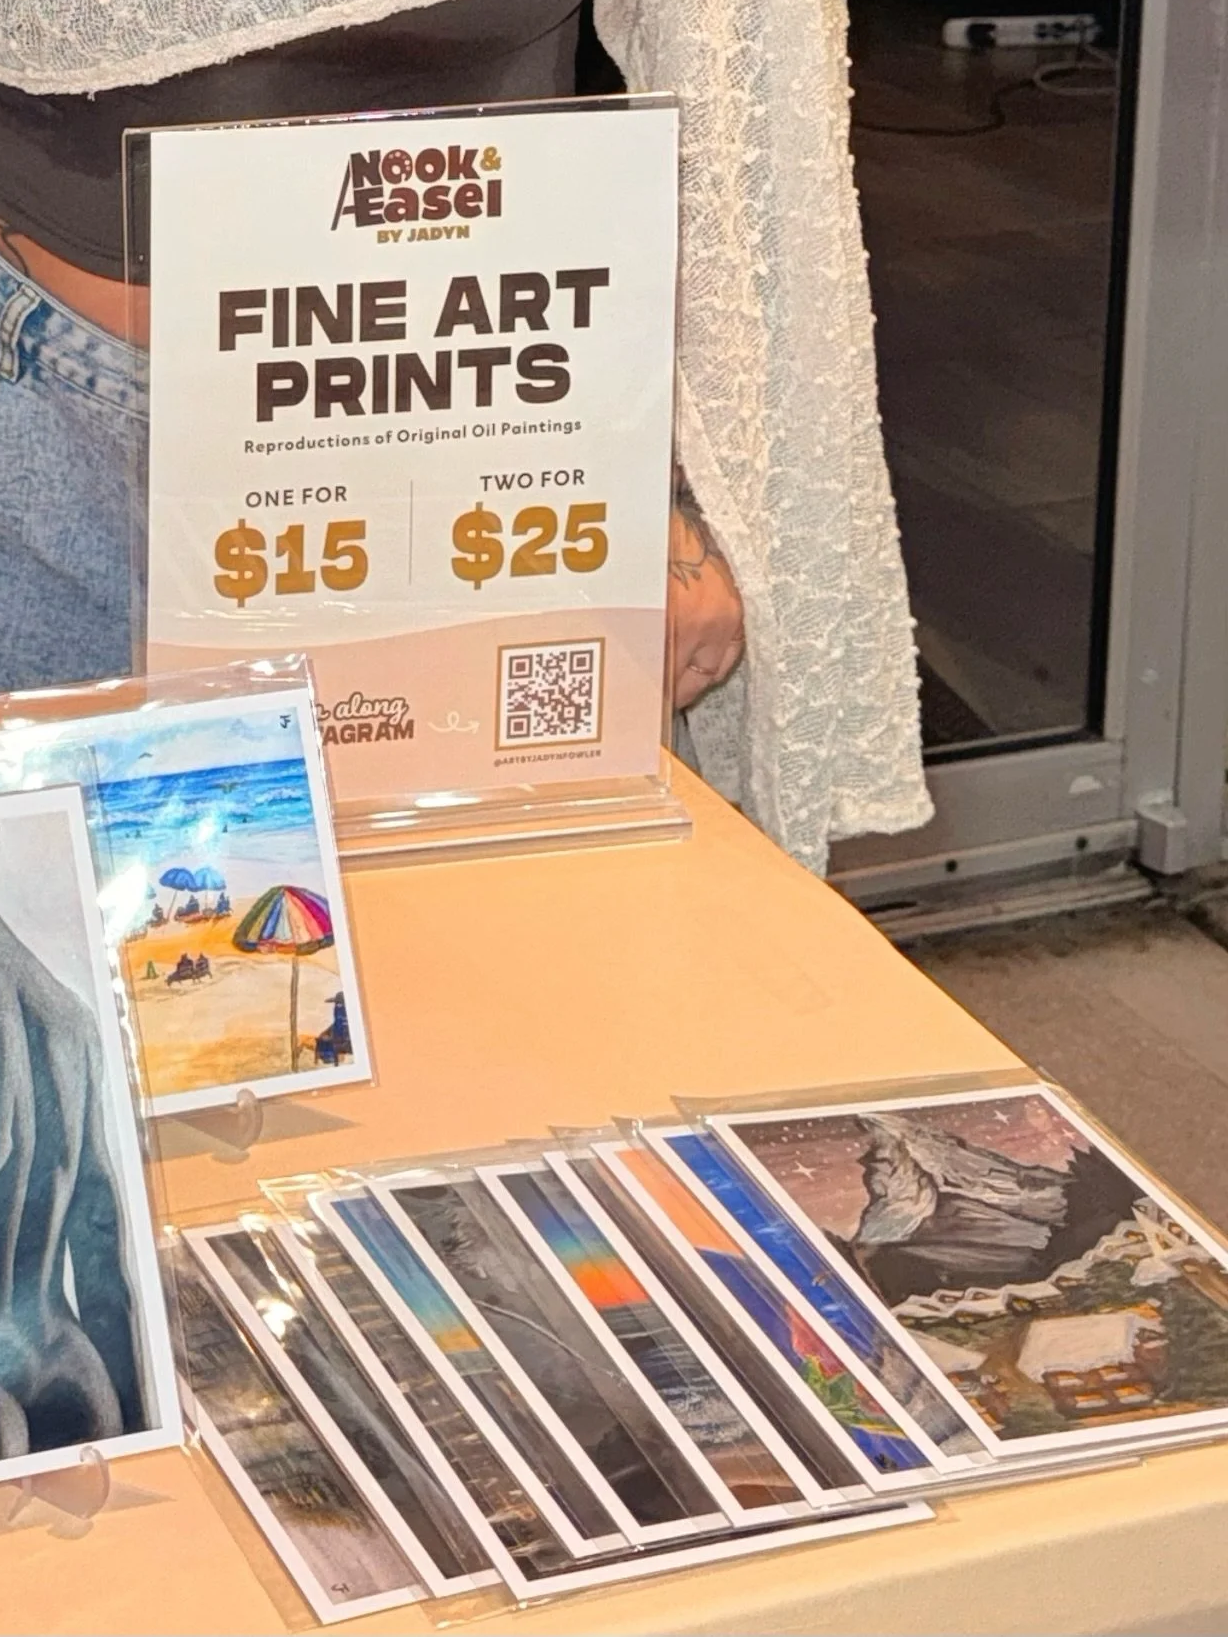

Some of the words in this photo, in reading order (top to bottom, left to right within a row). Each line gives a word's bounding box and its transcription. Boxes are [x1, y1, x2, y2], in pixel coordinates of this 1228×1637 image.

[350, 145, 481, 189] Nook
[480, 146, 502, 171] &
[350, 179, 502, 228] Easel
[377, 229, 403, 243] BY
[407, 225, 470, 242] JADYN
[219, 279, 408, 351] FINE
[434, 267, 610, 339] ART
[256, 343, 572, 423] PRINTS
[244, 434, 371, 455] Reproductions
[375, 430, 394, 445] of
[396, 425, 467, 444] Original
[472, 423, 496, 438] Oil
[501, 419, 583, 436] Paintings
[245, 489, 294, 508] ONE
[302, 485, 348, 504] FOR
[479, 472, 534, 492] TWO
[541, 469, 585, 488] FOR
[213, 519, 370, 608] $15
[451, 501, 609, 590] $25
[334, 691, 410, 726] along
[319, 718, 414, 746] AGRAM
